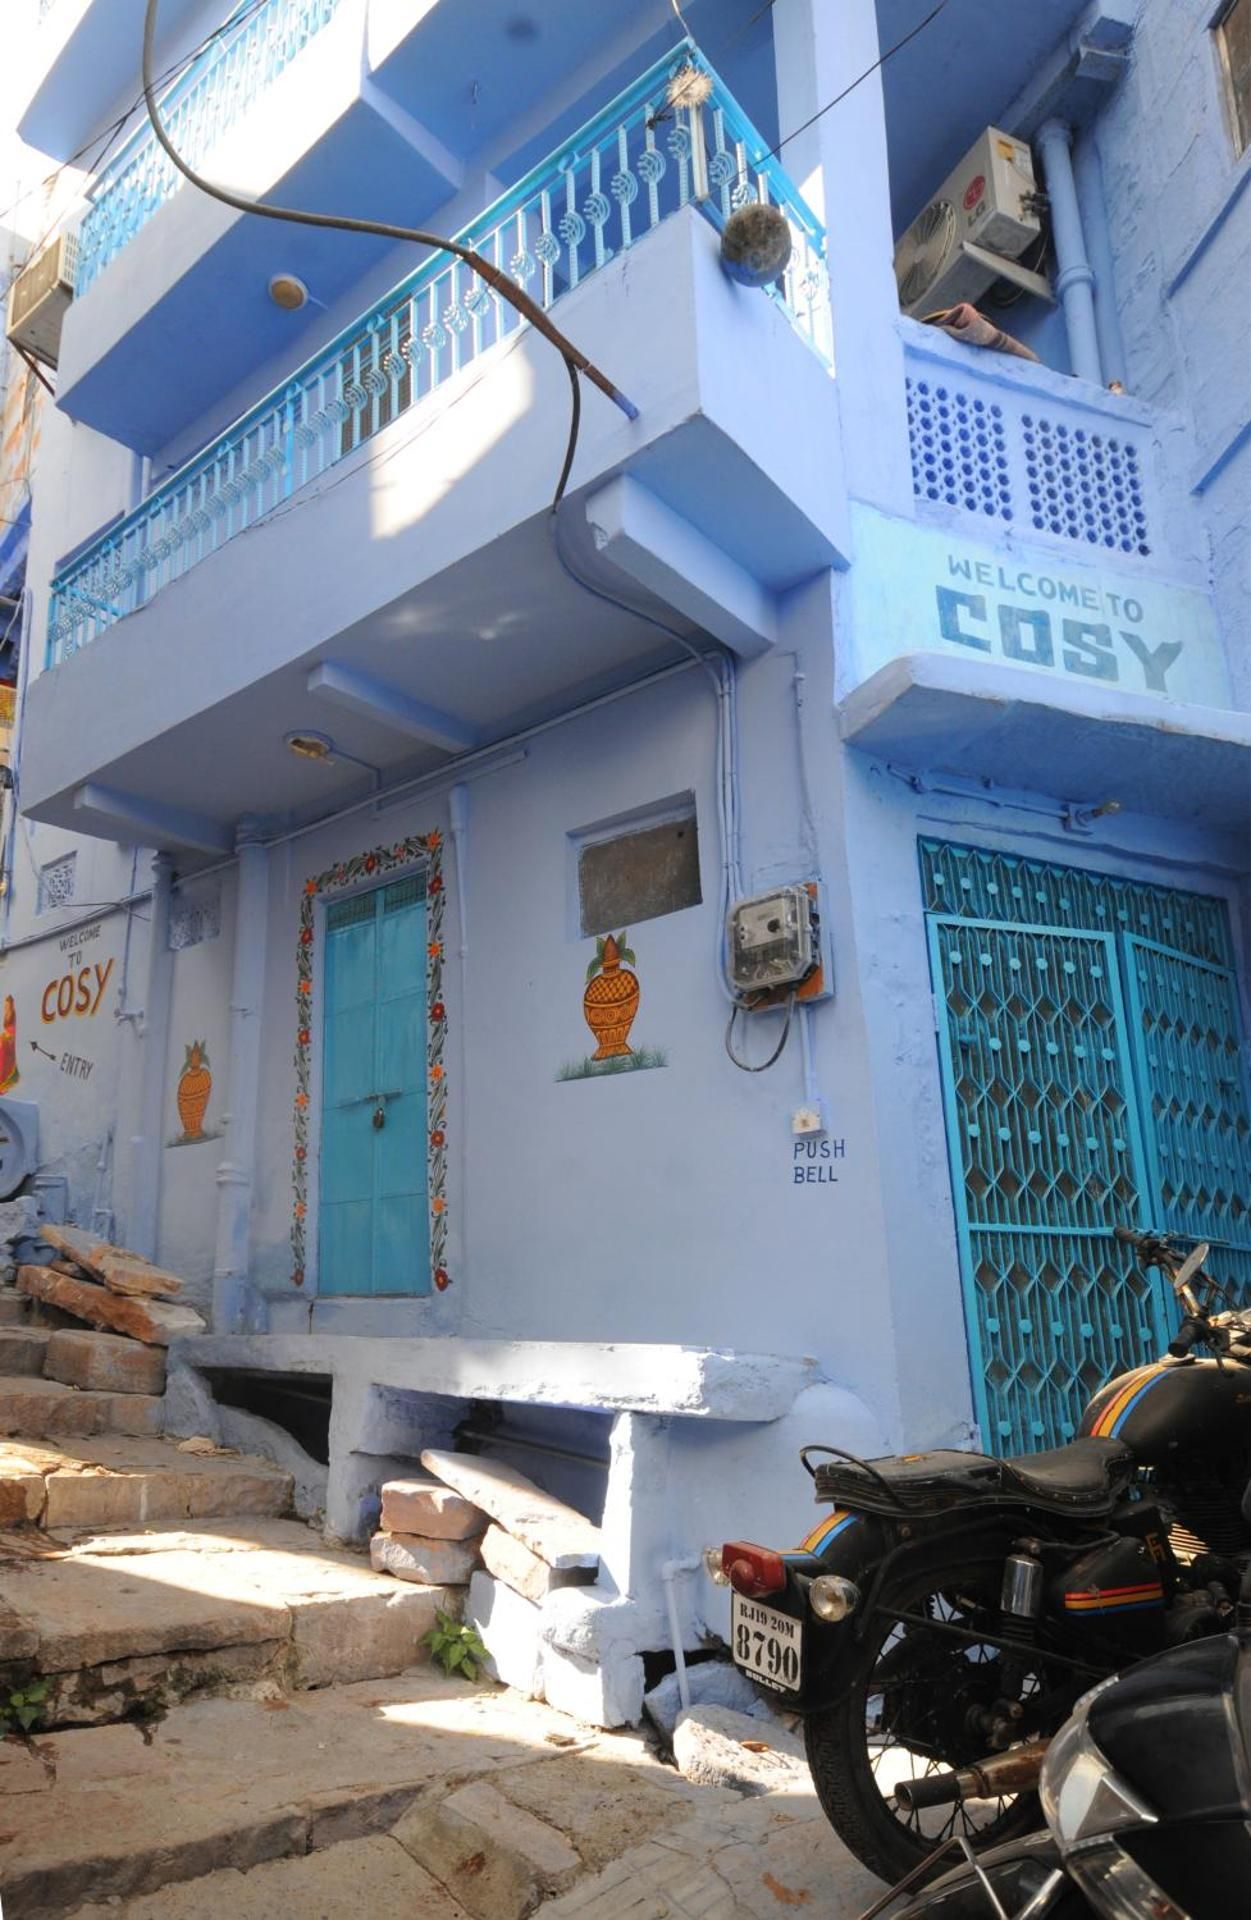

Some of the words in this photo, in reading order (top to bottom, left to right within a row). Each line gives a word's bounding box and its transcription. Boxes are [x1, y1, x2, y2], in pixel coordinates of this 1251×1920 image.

[967, 201, 986, 227] LG
[948, 555, 1100, 611] WELCOME
[1106, 592, 1144, 623] TO
[935, 584, 1183, 693] COSY
[59, 925, 101, 952] WELCOME
[68, 950, 82, 968] TO
[41, 958, 115, 1024] COSY
[60, 1052, 94, 1081] ENTRY
[793, 1139, 845, 1160] PUSH
[793, 1165, 838, 1184] BELL
[740, 1603, 767, 1625] RJ19
[737, 1624, 799, 1684] 8790
[745, 1669, 787, 1693] BULLET
